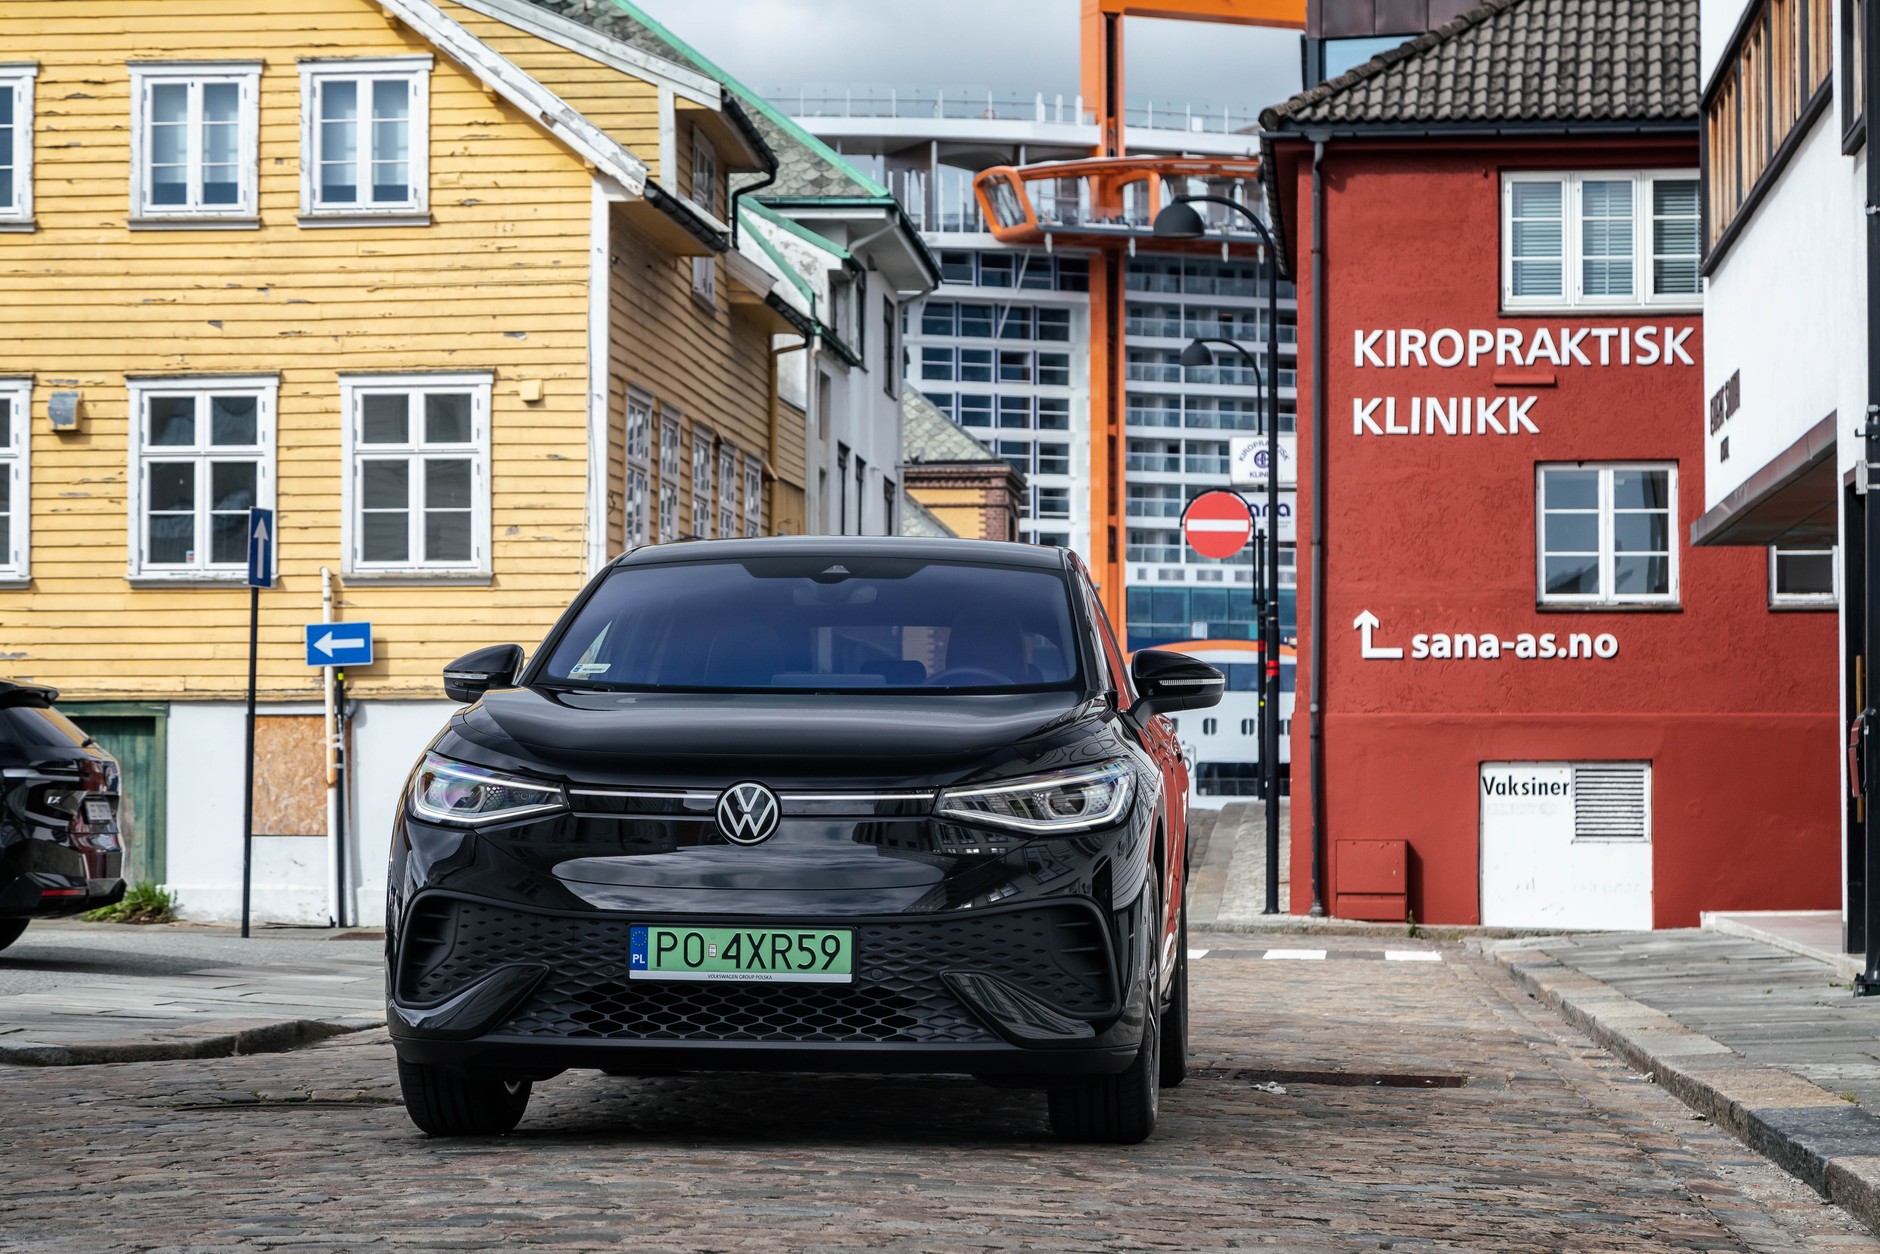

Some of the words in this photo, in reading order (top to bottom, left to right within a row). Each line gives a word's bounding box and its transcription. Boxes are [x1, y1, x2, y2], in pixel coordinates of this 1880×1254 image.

[1353, 326, 1694, 368] KIROPRAKTISK
[1353, 395, 1540, 436] KLINIKK
[1411, 632, 1619, 659] sana-as.no
[1482, 775, 1570, 796] Vaksiner
[632, 953, 646, 964] PL
[721, 932, 841, 970] 4XR59
